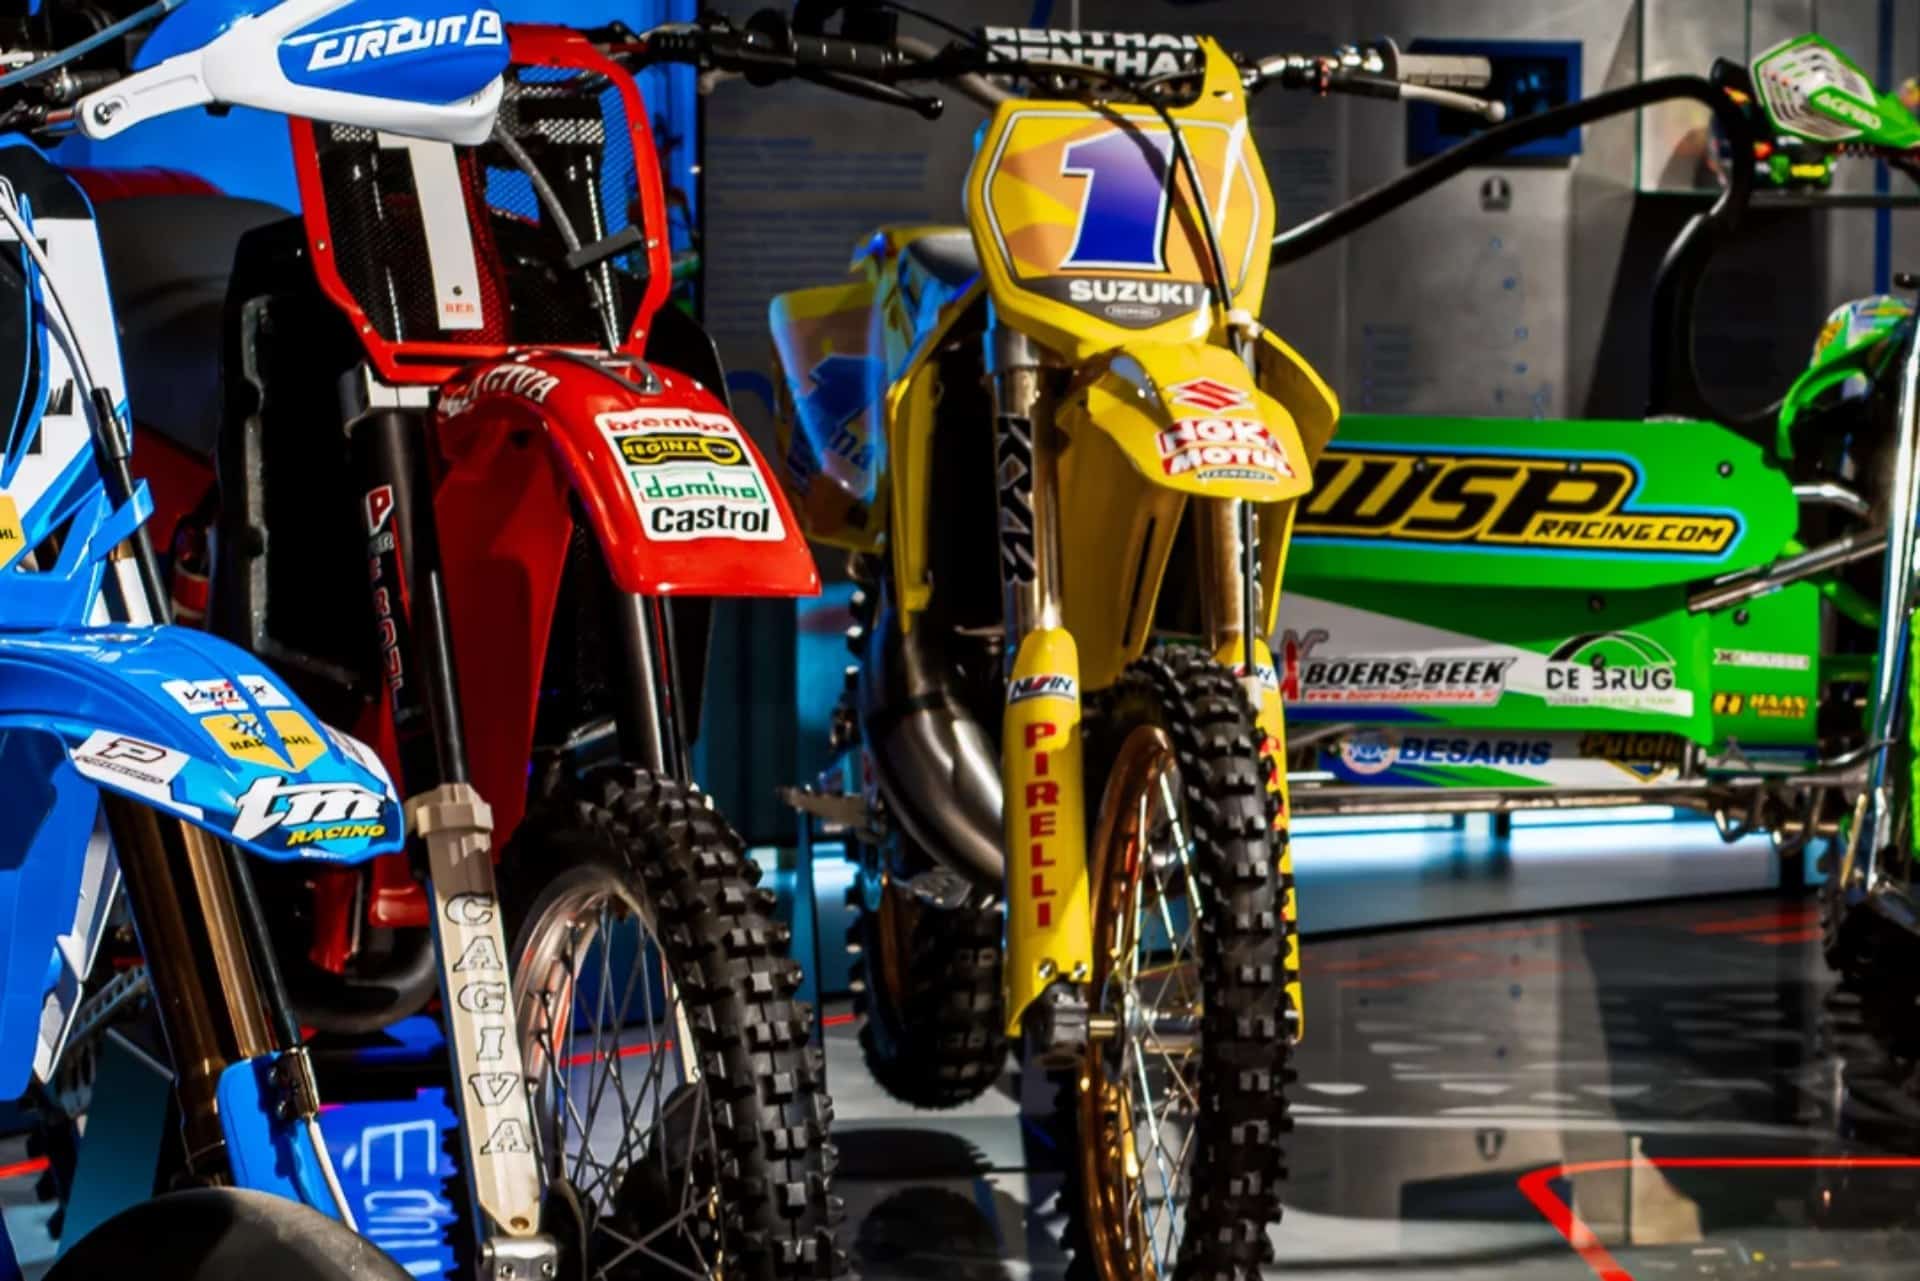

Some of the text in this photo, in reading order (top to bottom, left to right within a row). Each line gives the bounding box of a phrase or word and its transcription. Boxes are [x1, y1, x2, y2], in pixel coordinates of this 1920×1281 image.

[306, 15, 467, 71] CIRCUIT
[1059, 127, 1177, 272] 1
[1069, 279, 1195, 305] SUZUKI
[607, 416, 731, 433] brembo
[1168, 448, 1292, 475] MOTUL
[645, 471, 758, 499] domino
[651, 504, 770, 533] Castrol
[1532, 517, 1726, 544] RACING.COM
[1304, 660, 1505, 686] BOERS-BEEK
[1546, 667, 1673, 691] DE BRUG
[1396, 738, 1552, 765] BESARIS
[287, 824, 386, 846] RACING
[1024, 723, 1060, 928] PIRELLI
[444, 891, 531, 1156] CAGIVA
